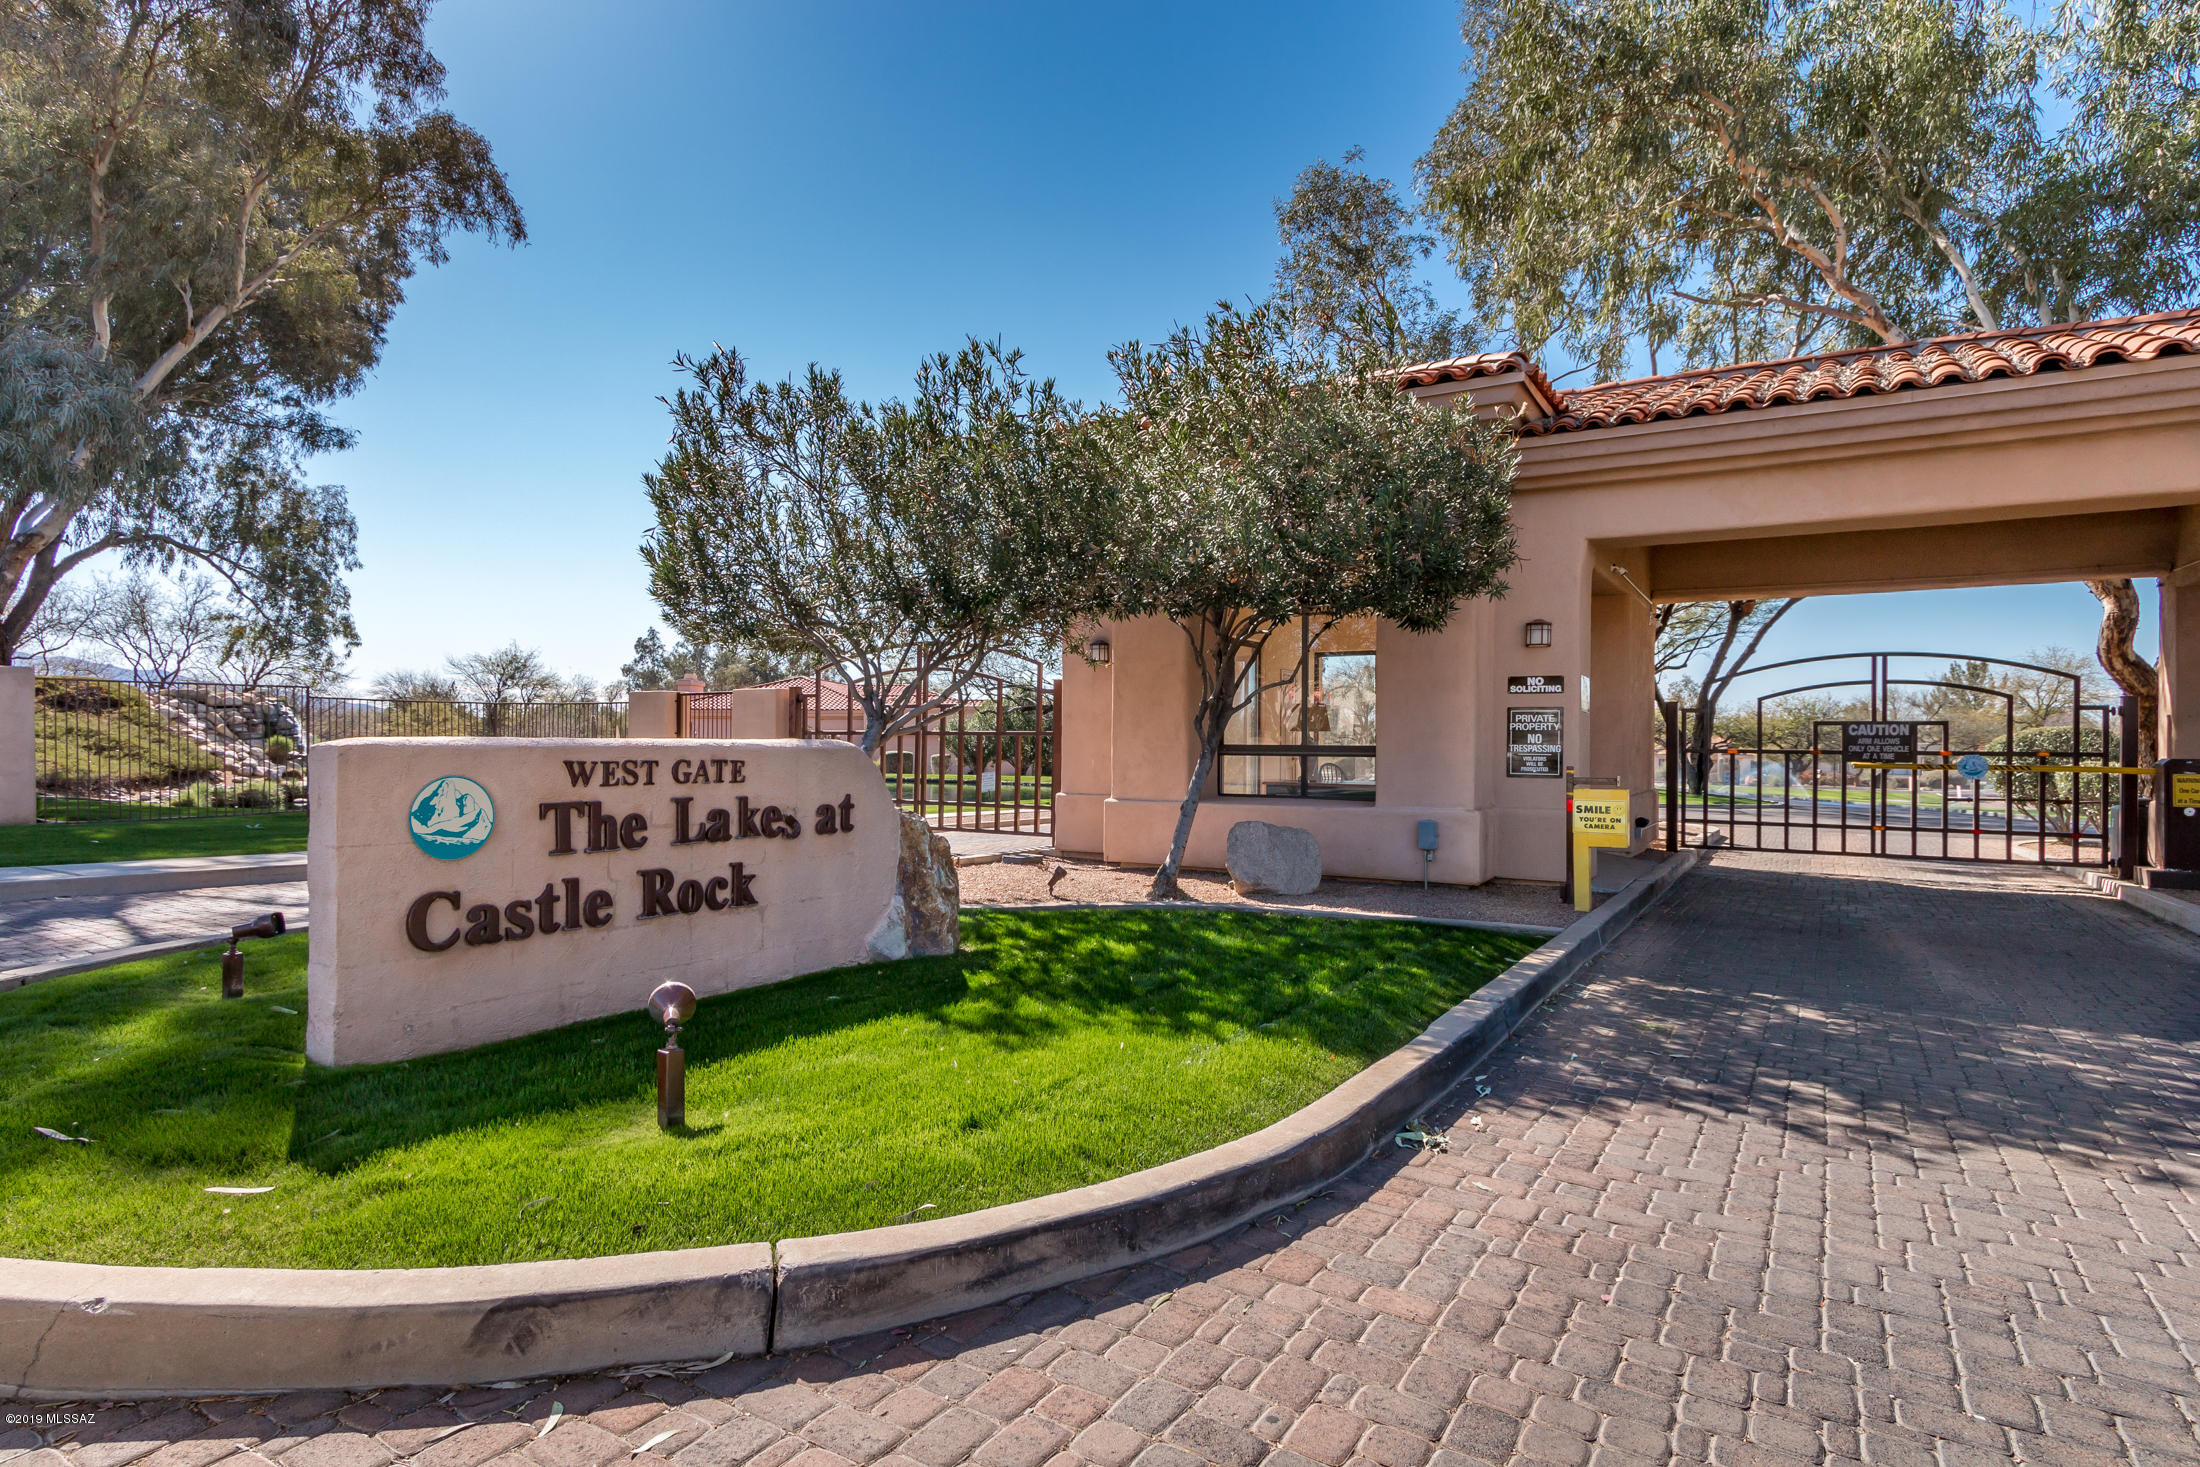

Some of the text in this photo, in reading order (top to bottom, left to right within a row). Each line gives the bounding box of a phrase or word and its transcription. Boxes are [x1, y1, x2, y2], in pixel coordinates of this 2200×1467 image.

[1527, 677, 1545, 686] NO
[1510, 685, 1562, 693] SOLICITING
[1515, 714, 1555, 723] PRIVATE
[1509, 722, 1560, 731] PROPERTY
[1848, 724, 1910, 736] CAUTION
[1527, 733, 1543, 744] NO
[1509, 744, 1562, 753] TRESPASSING
[563, 759, 746, 788] WEST GATE
[1575, 804, 1611, 814] SMILE
[539, 793, 855, 857] The Lakes at
[406, 862, 758, 952] Castle Rock
